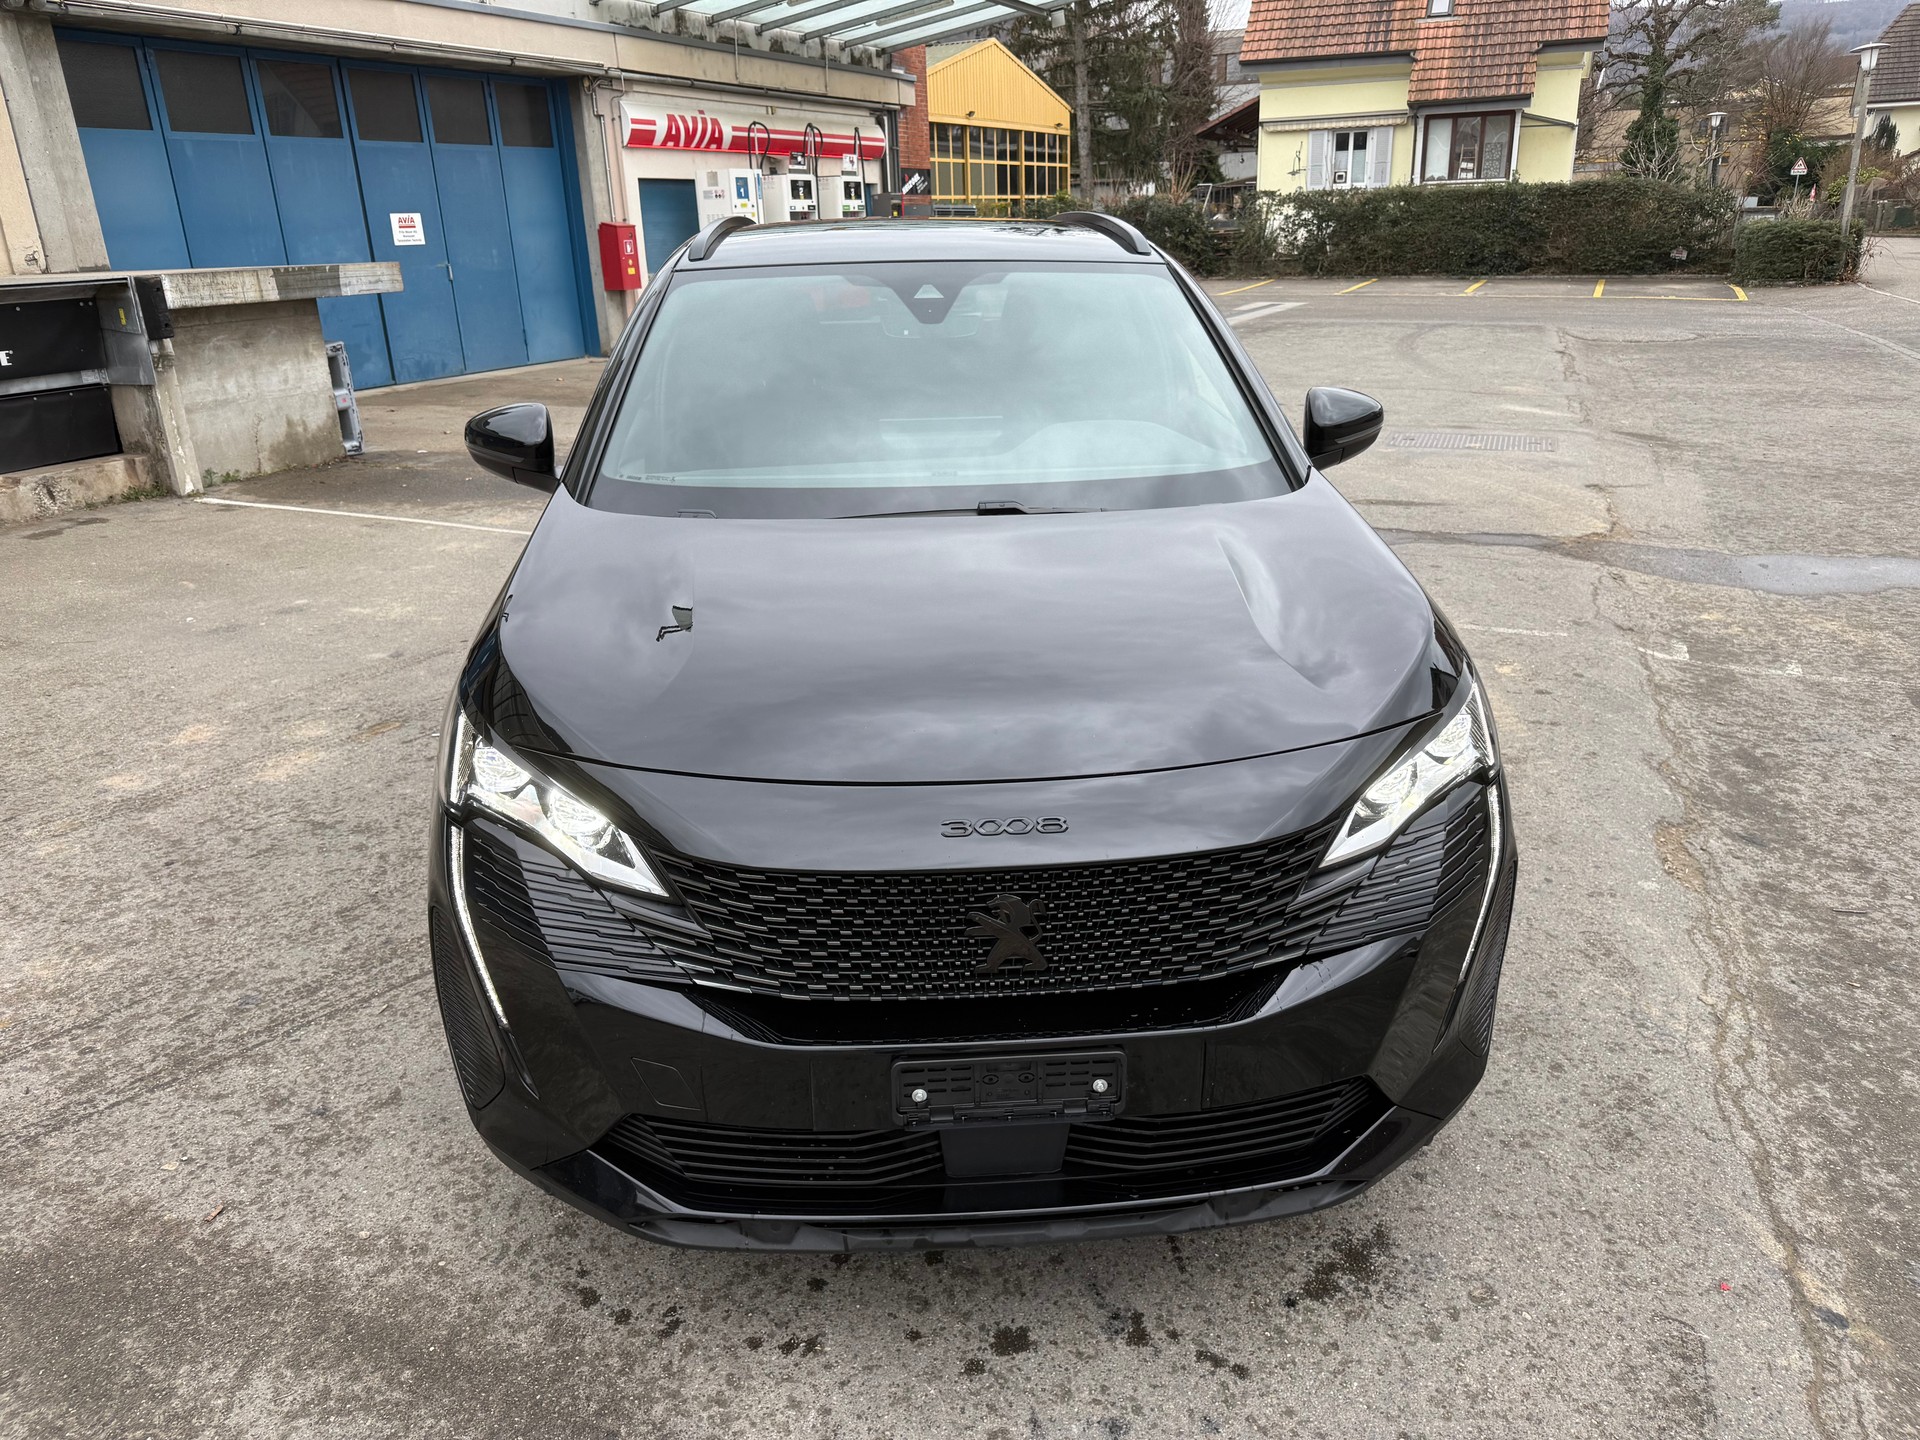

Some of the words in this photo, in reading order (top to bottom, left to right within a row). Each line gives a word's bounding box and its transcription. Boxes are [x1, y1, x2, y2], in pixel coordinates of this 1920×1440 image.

[660, 110, 723, 149] AVIA
[740, 187, 745, 197] 1
[799, 187, 804, 196] 2
[398, 215, 415, 224] AVIA
[941, 816, 1068, 837] 3008
